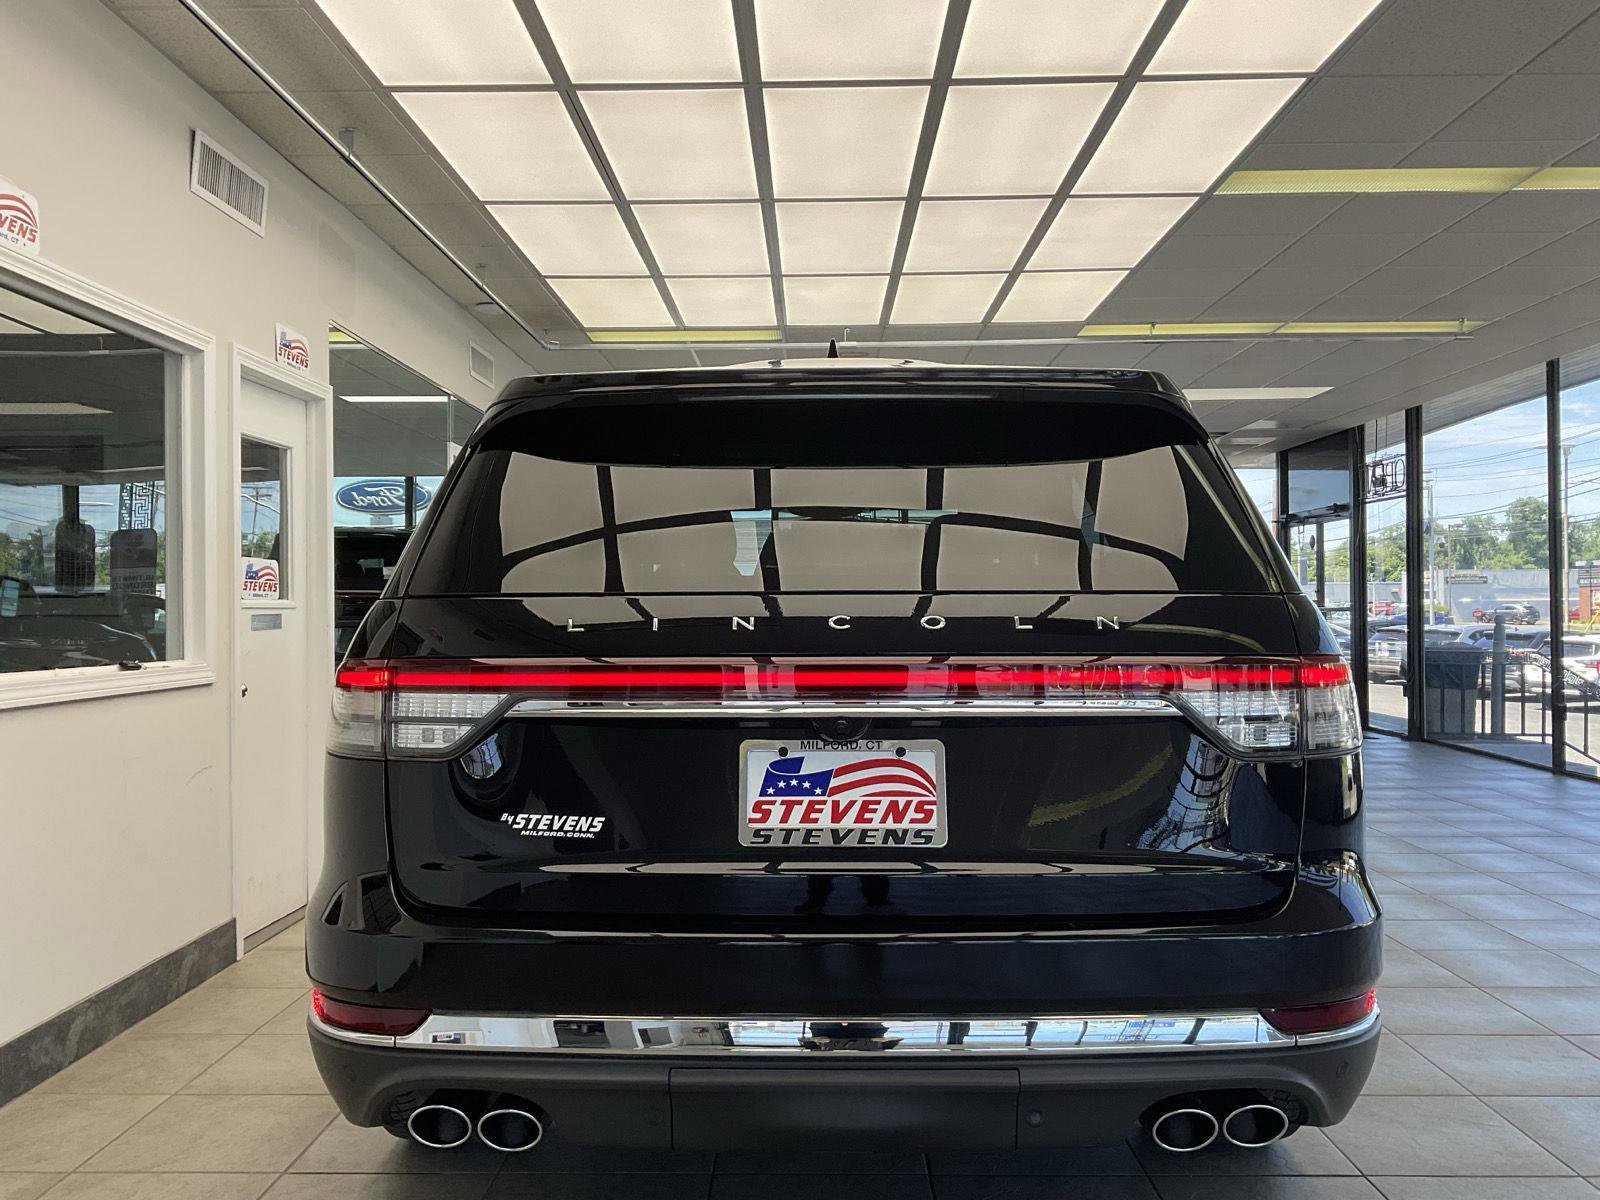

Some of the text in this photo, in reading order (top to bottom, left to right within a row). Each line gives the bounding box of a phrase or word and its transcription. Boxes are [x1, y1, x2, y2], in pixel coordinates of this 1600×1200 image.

[278, 346, 309, 368] STEVENS
[242, 581, 278, 592] STEVENS
[566, 615, 1120, 632] LINCOLN
[866, 740, 883, 750] CT
[748, 799, 938, 824] STEVENS
[512, 813, 606, 832] STEVENS
[750, 828, 936, 845] STEVENS
